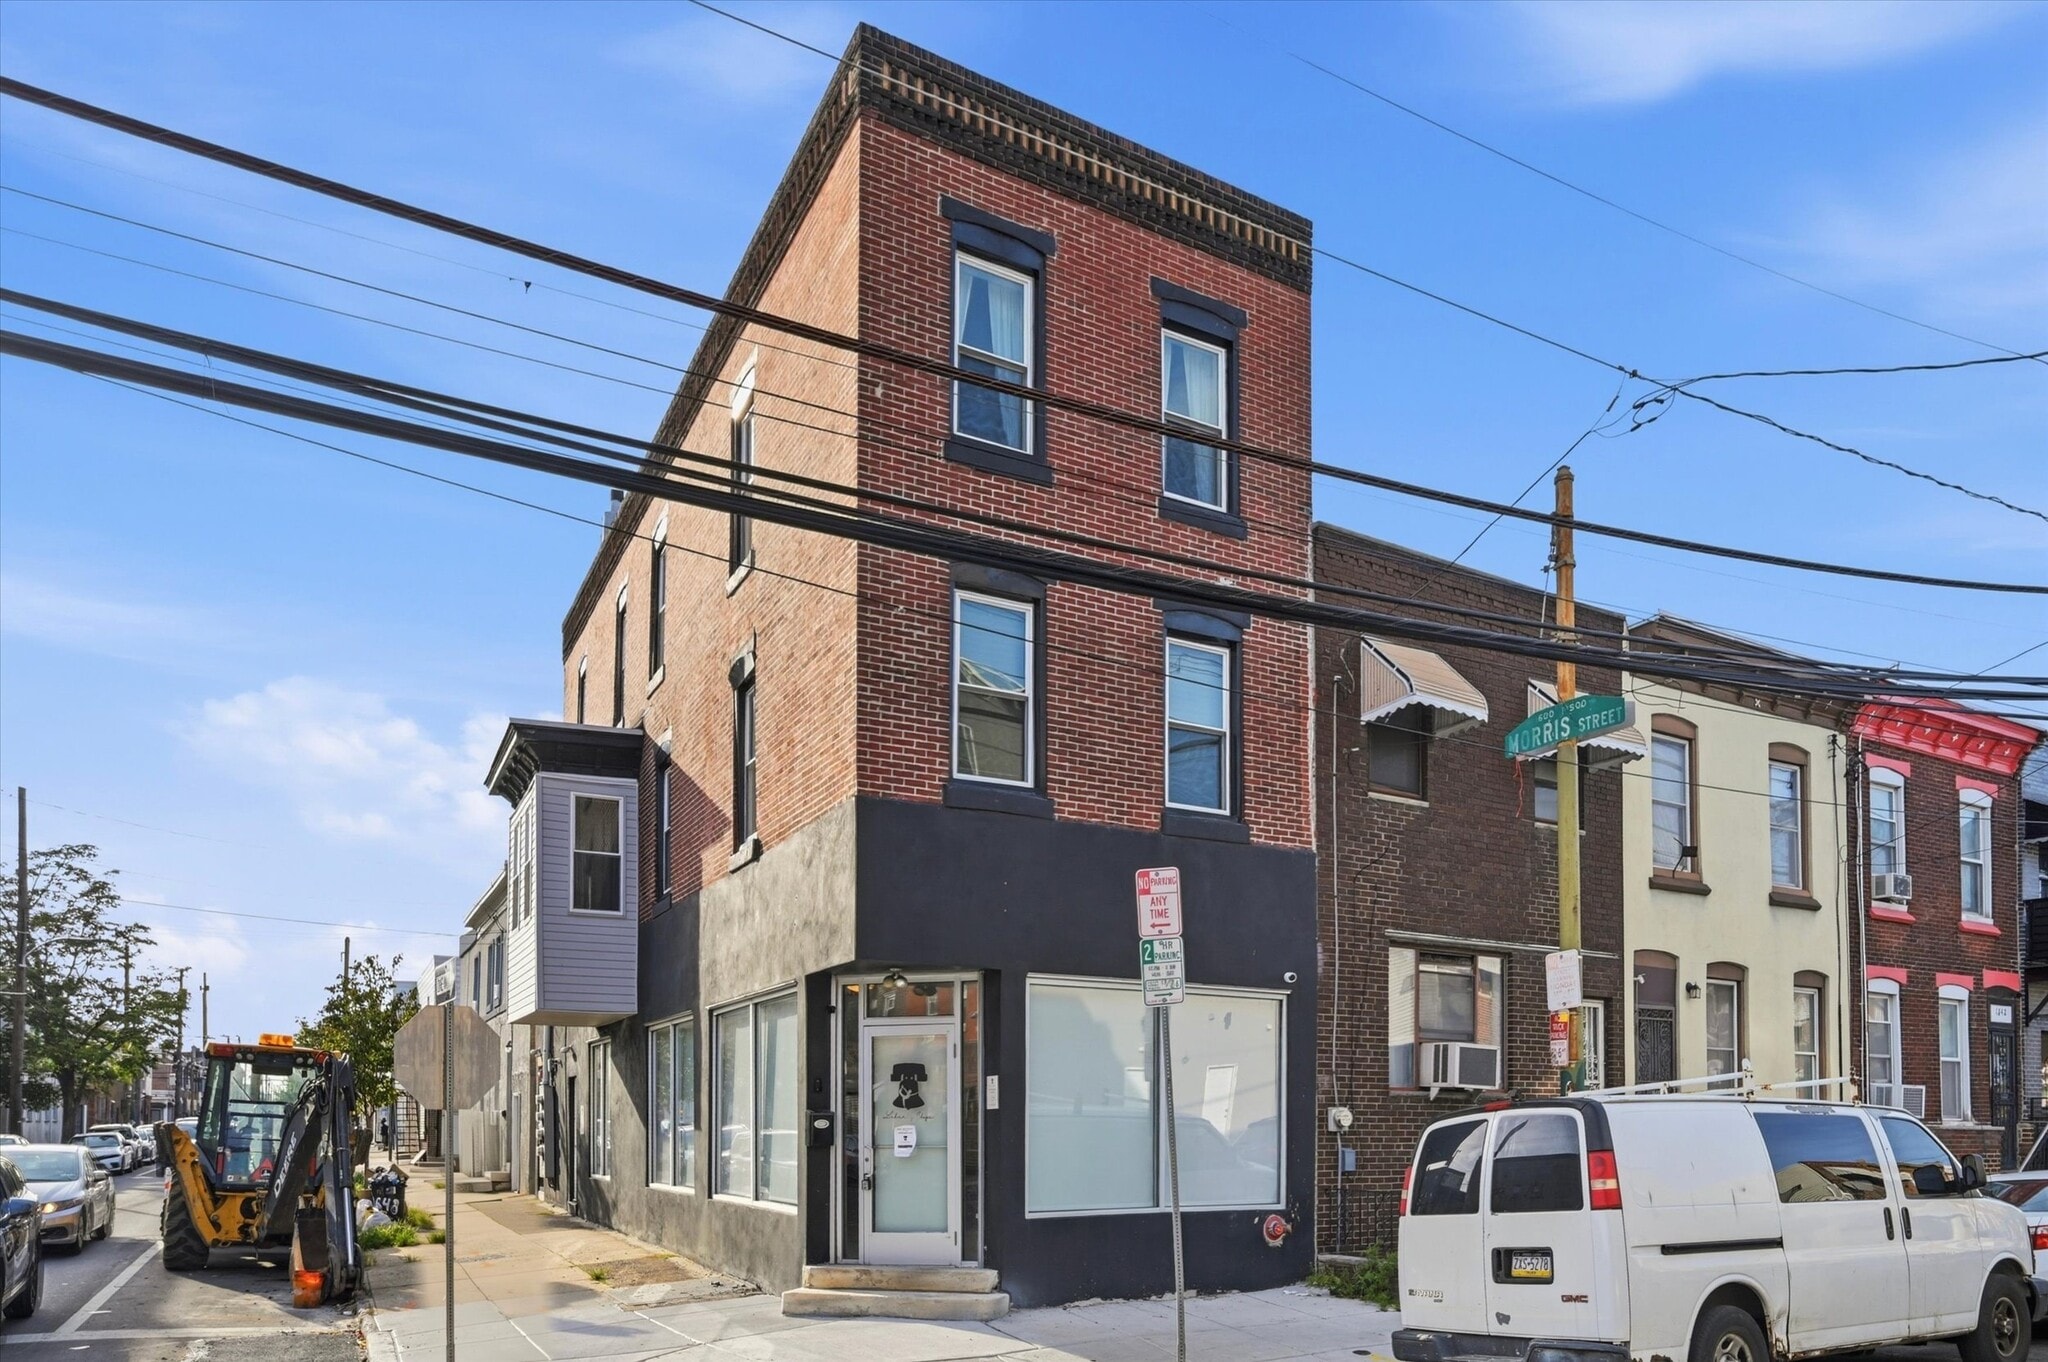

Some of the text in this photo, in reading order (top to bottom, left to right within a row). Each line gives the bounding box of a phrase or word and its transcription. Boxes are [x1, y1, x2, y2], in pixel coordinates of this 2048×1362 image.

[1569, 699, 1586, 712] 500
[1508, 706, 1622, 753] MORRIS STREET
[1138, 876, 1177, 890] NO PARKING
[1150, 895, 1168, 907] ANY
[1150, 908, 1170, 920] TIME
[1143, 943, 1152, 961] 2
[1154, 950, 1181, 962] PARKING
[274, 1131, 297, 1198] DEERE
[375, 1197, 400, 1215] 648
[1561, 1294, 1589, 1304] GMC
